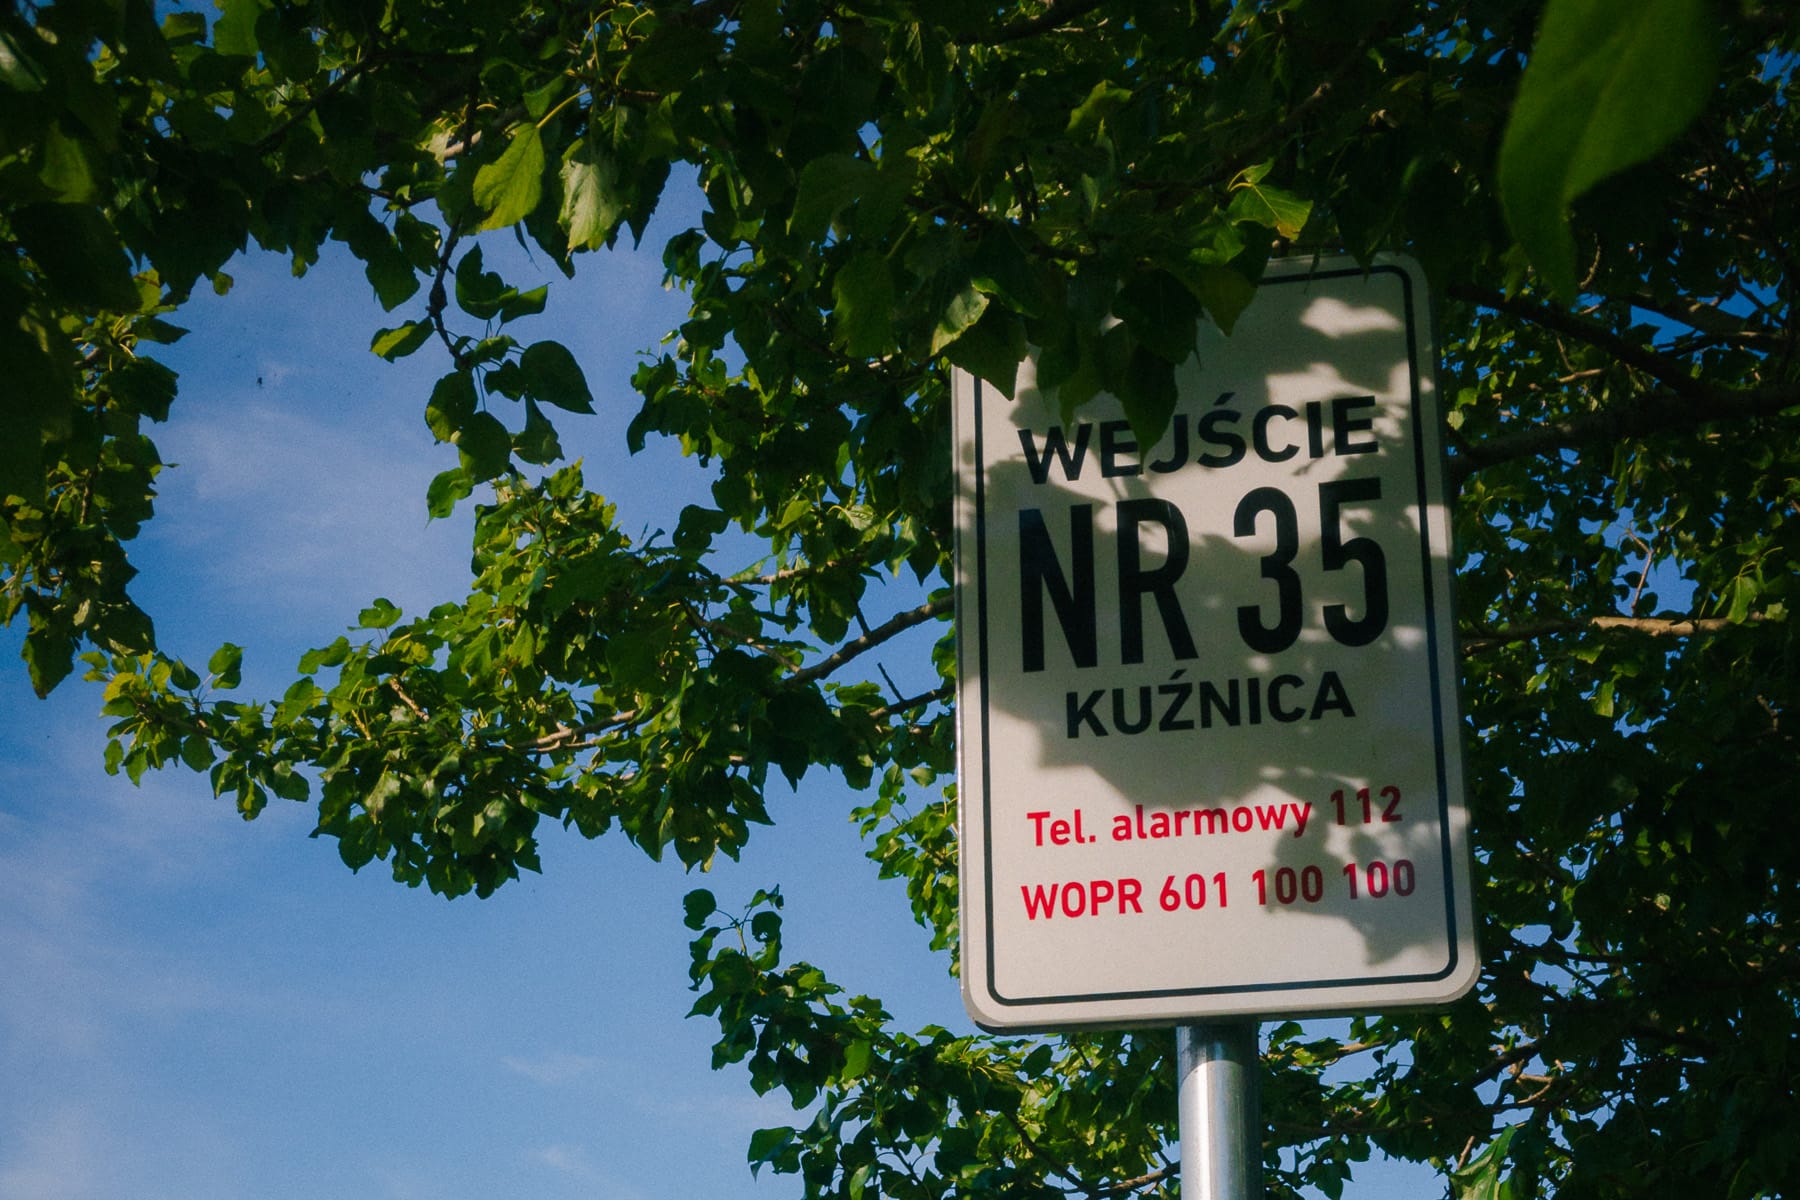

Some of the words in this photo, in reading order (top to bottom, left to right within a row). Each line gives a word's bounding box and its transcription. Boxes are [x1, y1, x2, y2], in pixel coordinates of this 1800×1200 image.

[1018, 392, 1379, 484] WEJŚCIE
[1018, 497, 1198, 673] NR
[1233, 477, 1388, 655] 35
[1067, 668, 1355, 739] KUŹNICA
[1027, 809, 1096, 847] Tel.
[1112, 801, 1312, 840] alarmowy
[1330, 785, 1402, 827] 112
[1021, 878, 1143, 921] WOPR
[1159, 873, 1228, 912] 601
[1251, 866, 1324, 906] 100
[1343, 859, 1416, 900] 100
